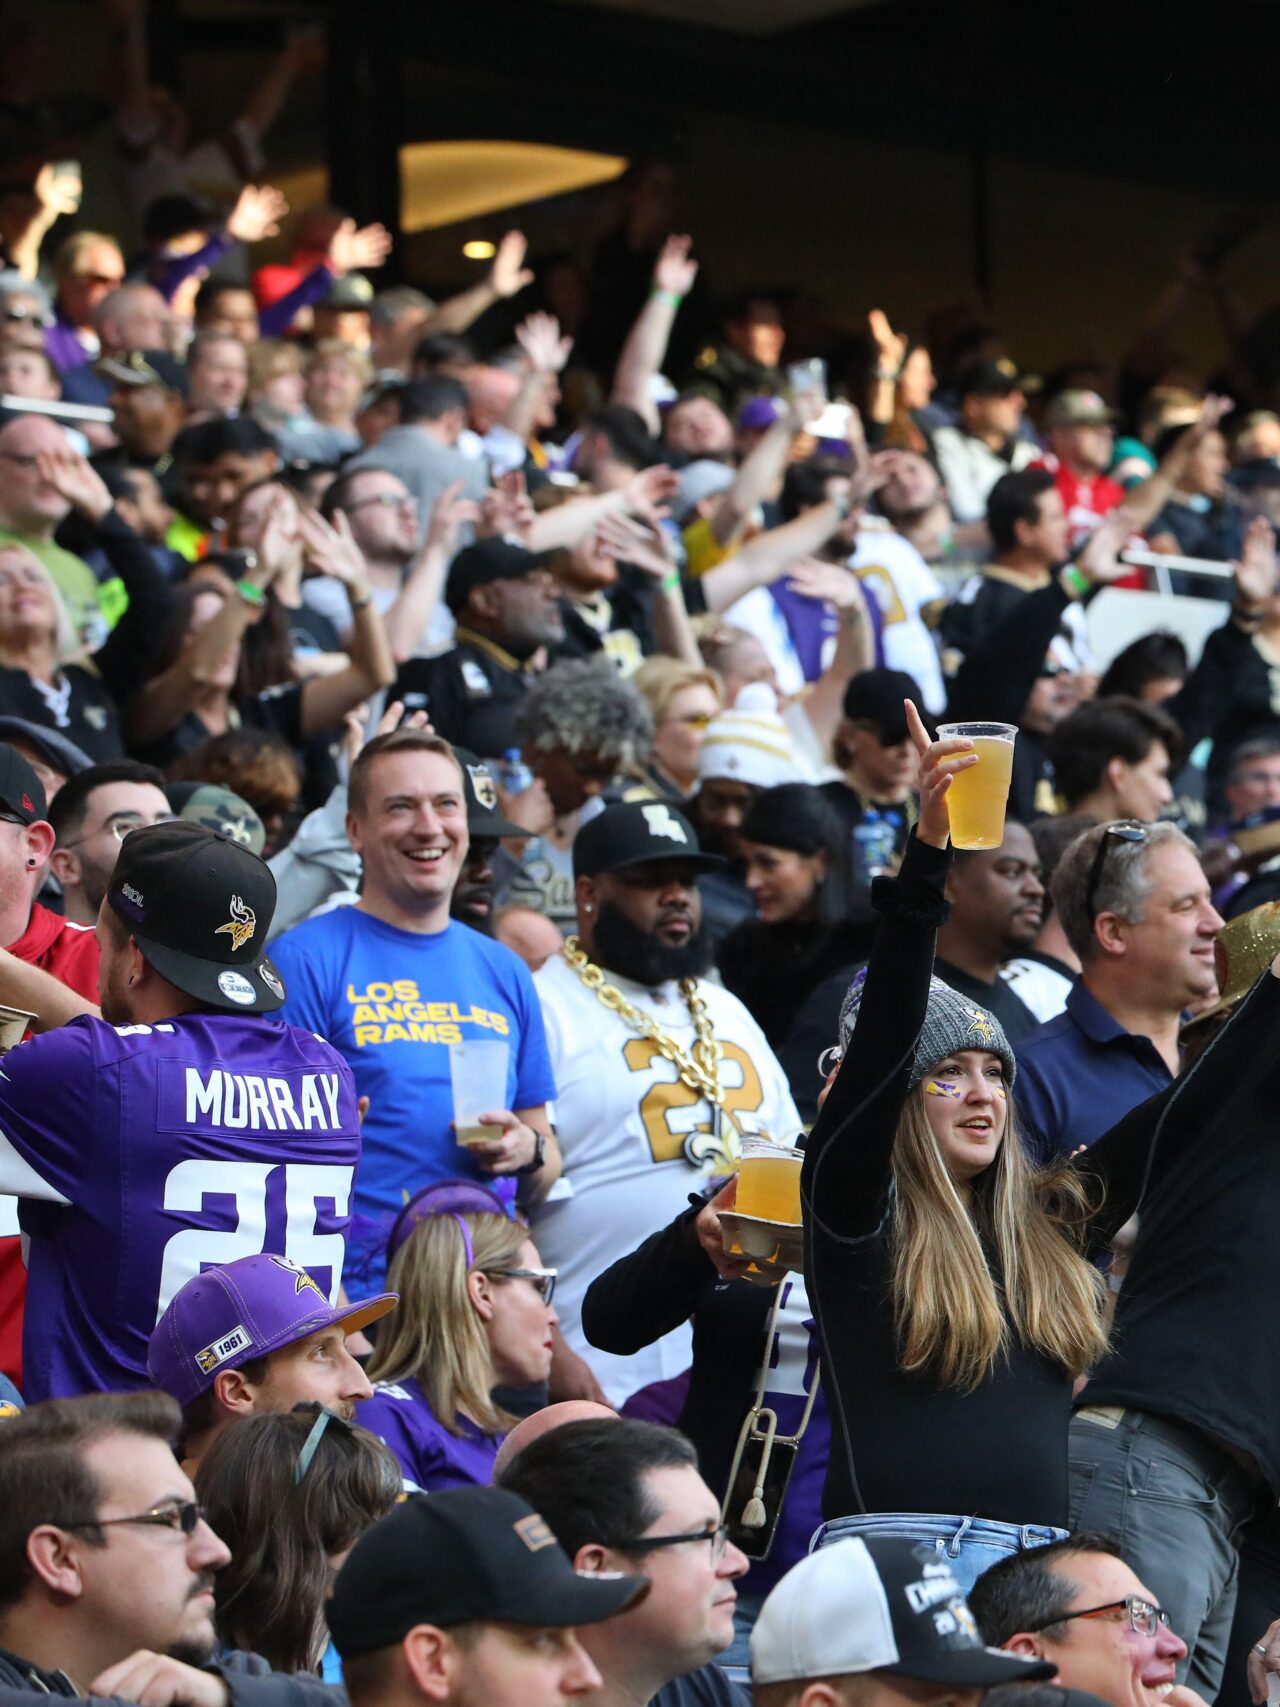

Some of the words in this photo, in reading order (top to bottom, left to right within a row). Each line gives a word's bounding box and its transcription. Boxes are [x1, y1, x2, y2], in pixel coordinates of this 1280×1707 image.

[346, 979, 420, 1004] LOS
[352, 1002, 510, 1036] ANGELES
[354, 1022, 463, 1048] RAMS
[185, 1067, 343, 1131] MURRAY
[218, 1333, 243, 1356] 1961
